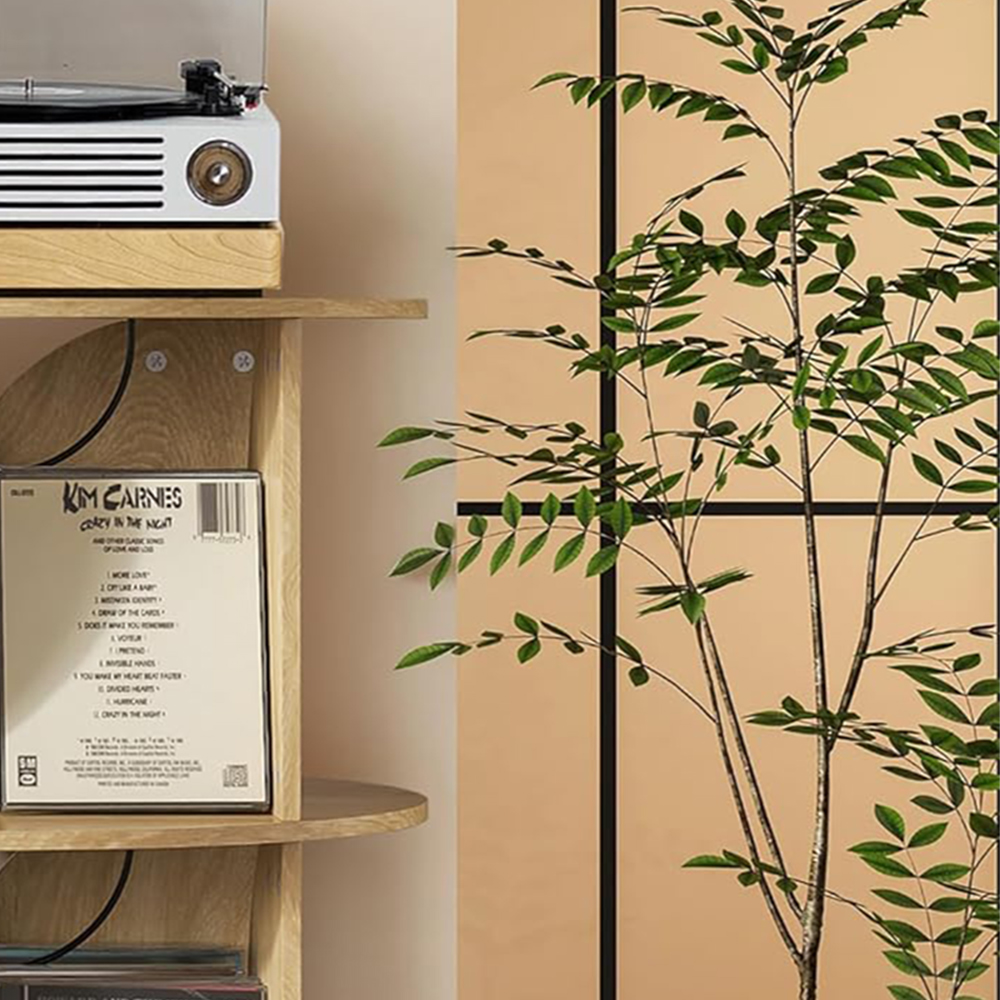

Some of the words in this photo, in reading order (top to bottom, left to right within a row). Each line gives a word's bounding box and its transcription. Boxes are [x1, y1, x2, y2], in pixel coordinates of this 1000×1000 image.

[63, 481, 98, 514] KIM
[103, 484, 182, 511] CARNES
[80, 516, 111, 532] CRAZY
[114, 516, 124, 528] IN
[126, 516, 142, 529] THE
[146, 517, 173, 530] NIGHT
[106, 537, 124, 545] OTHER
[112, 571, 130, 579] MORE
[80, 672, 93, 680] YOU
